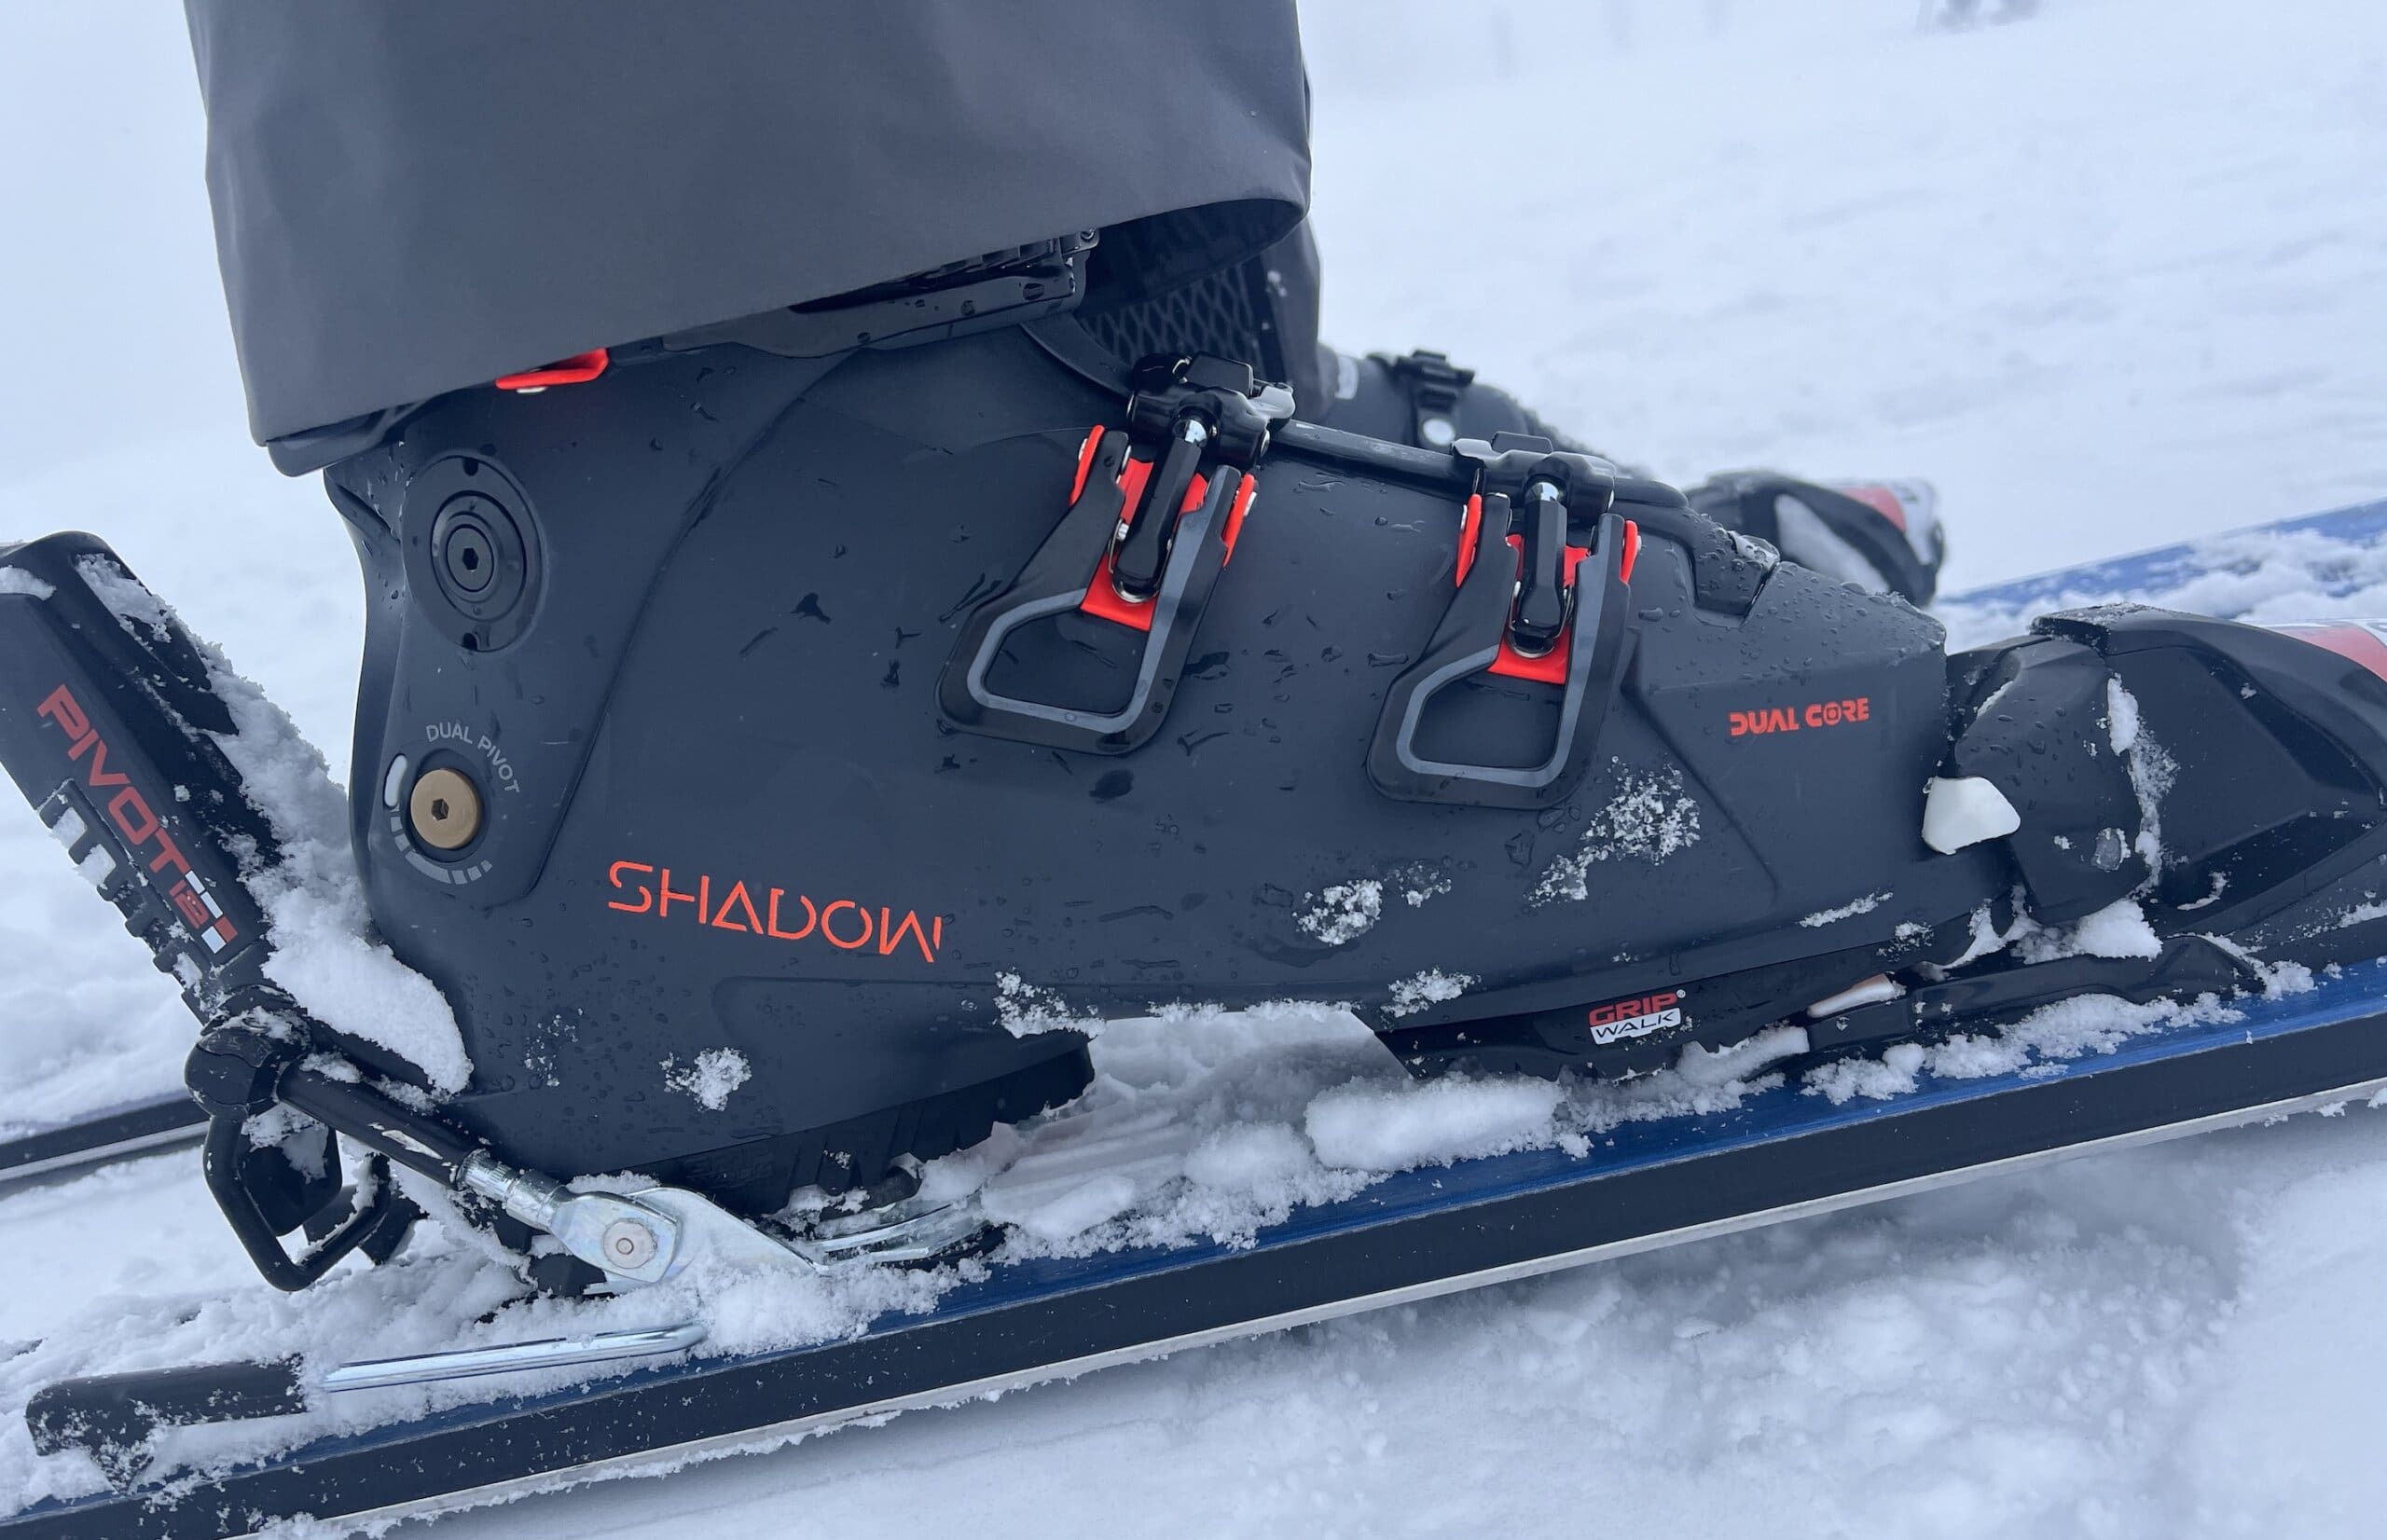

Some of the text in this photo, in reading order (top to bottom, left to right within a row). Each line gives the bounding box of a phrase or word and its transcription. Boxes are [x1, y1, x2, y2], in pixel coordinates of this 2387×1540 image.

[1730, 697, 1870, 736] DUAL CORE
[37, 684, 191, 873] PIVOT
[426, 722, 520, 793] DUAL PIVOT
[608, 860, 943, 963] SHADOW
[1595, 1011, 1675, 1038] WALK
